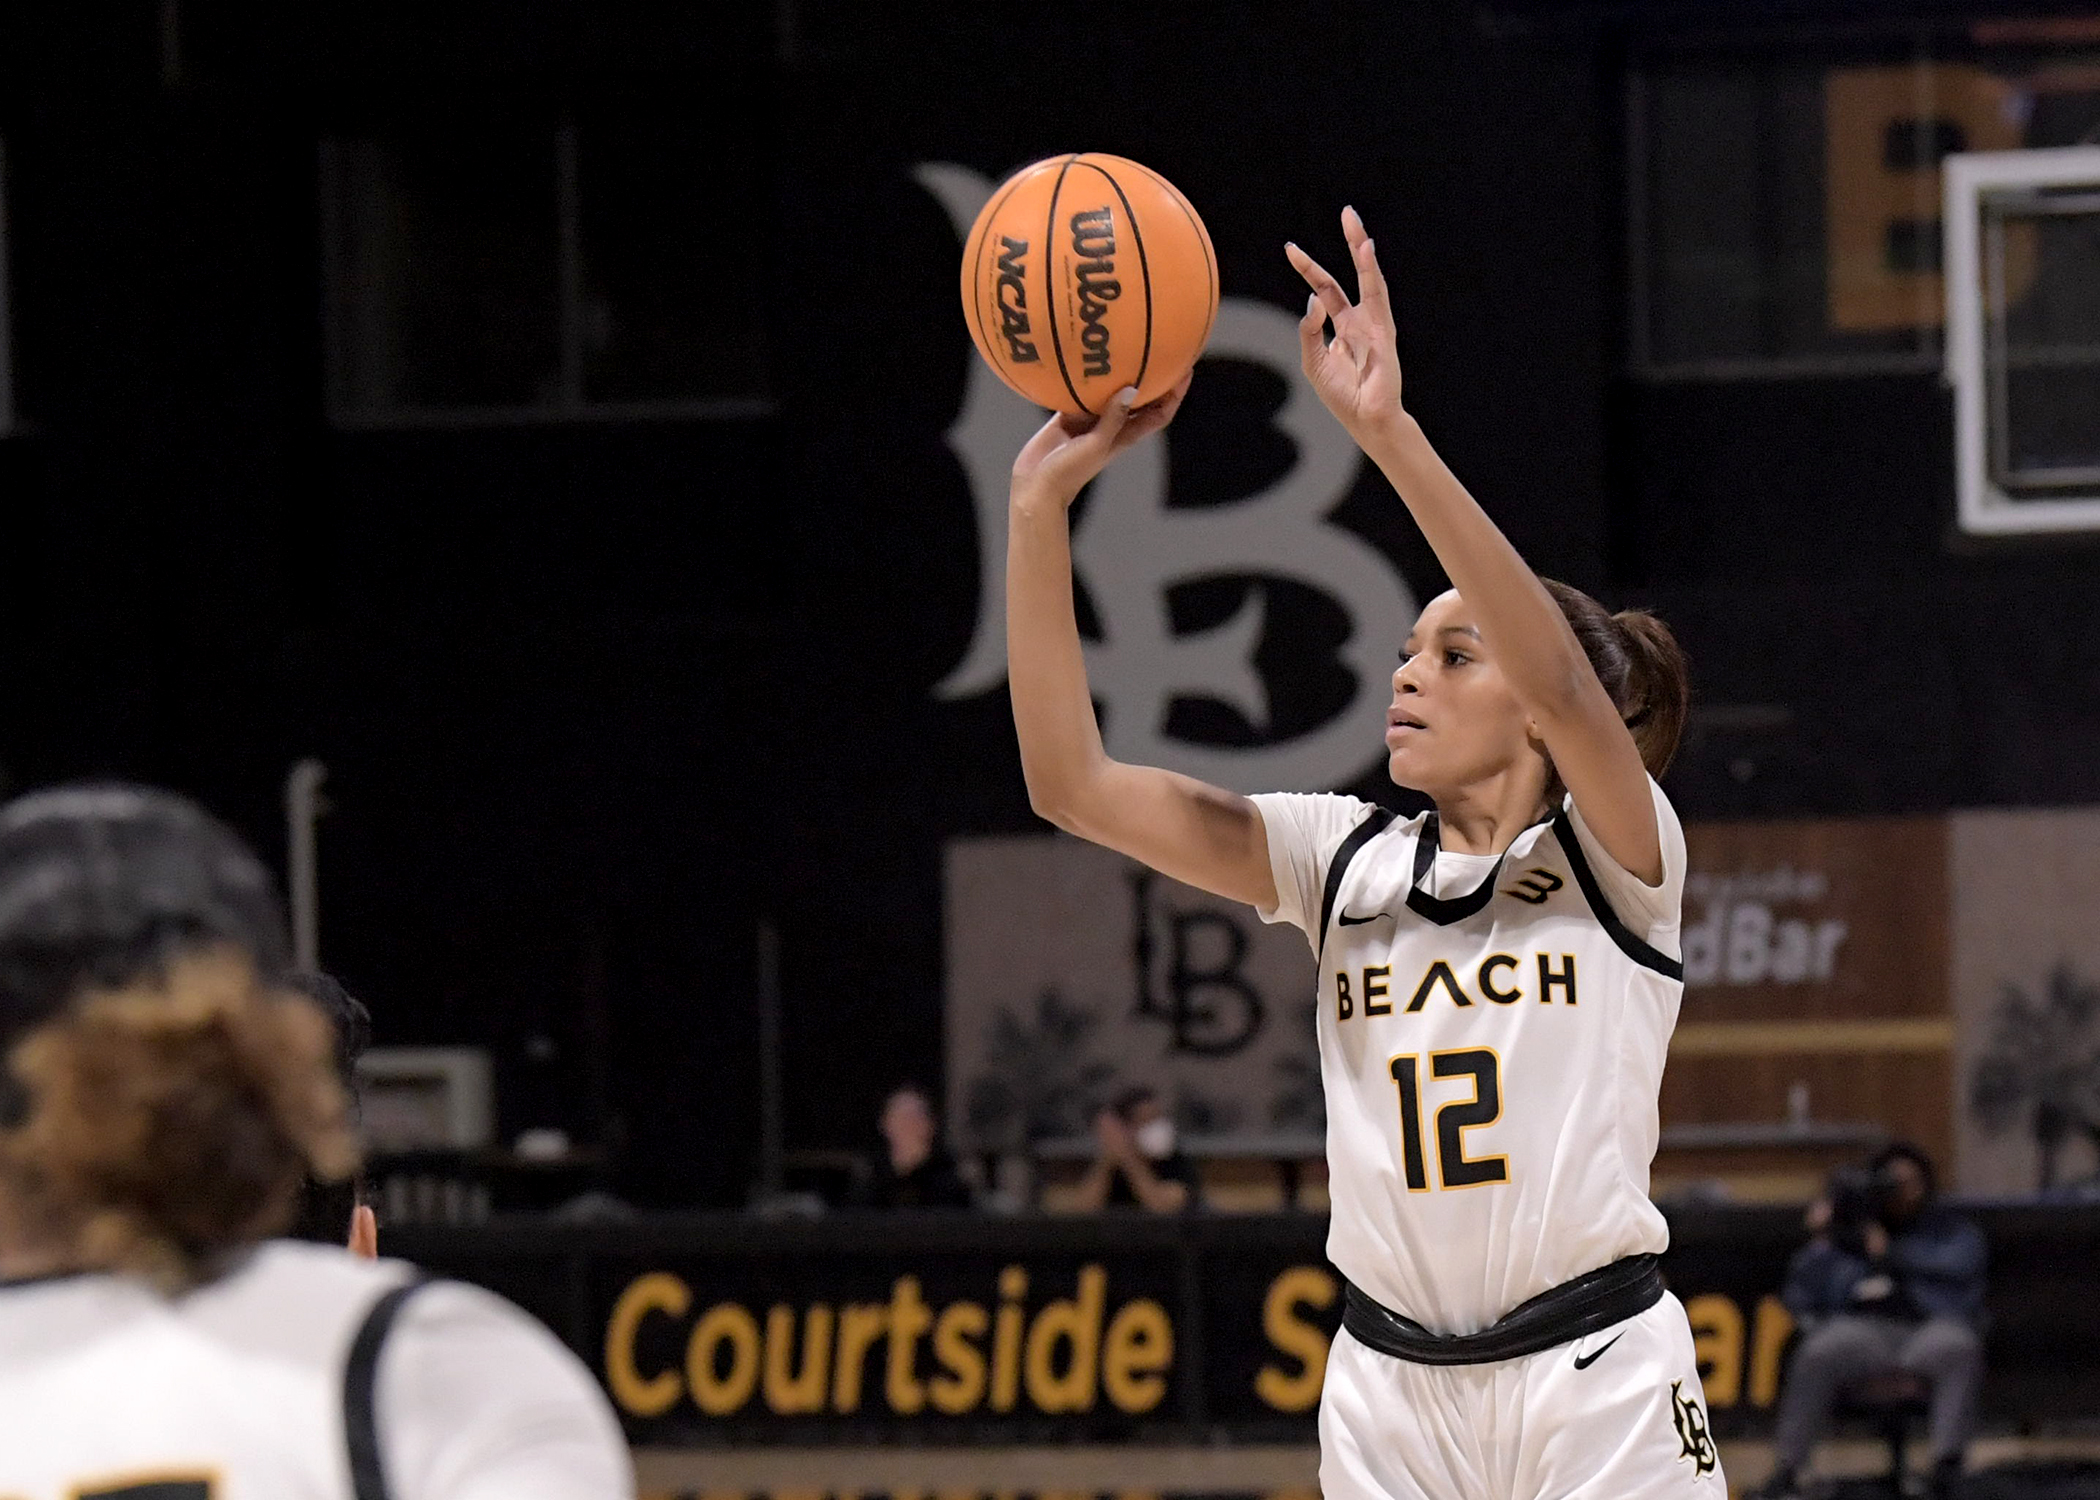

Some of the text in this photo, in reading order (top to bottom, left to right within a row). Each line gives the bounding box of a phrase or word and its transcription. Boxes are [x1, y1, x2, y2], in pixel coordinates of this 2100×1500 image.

[997, 235, 1041, 364] NCAA
[1070, 205, 1121, 379] Wilson
[1335, 951, 1578, 1022] BEACH
[1387, 1045, 1511, 1193] 12
[604, 1263, 1174, 1415] Courtside
